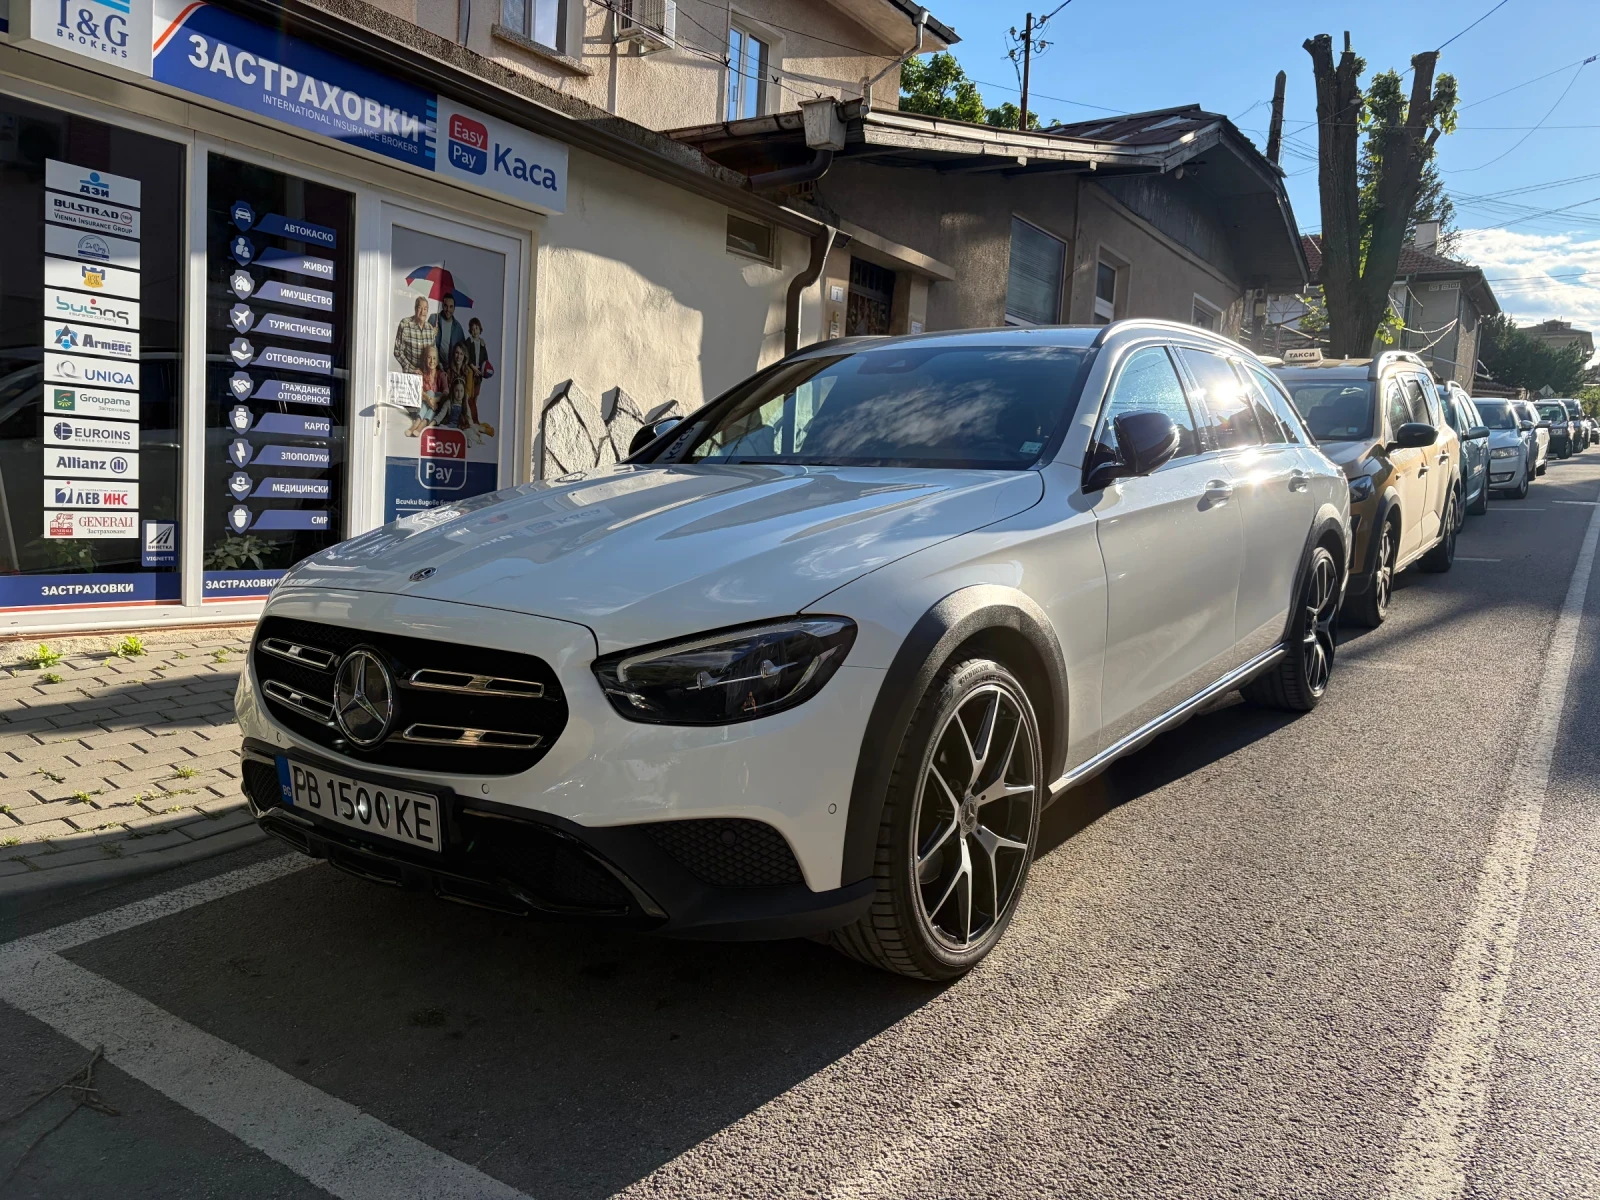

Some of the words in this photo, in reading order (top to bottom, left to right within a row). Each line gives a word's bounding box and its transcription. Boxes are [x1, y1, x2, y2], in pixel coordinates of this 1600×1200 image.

[58, 0, 129, 47] I&G
[56, 28, 128, 58] BROKERS
[188, 34, 419, 142] ЗАСТРАХОВКИ
[262, 94, 332, 125] INTERNATIONAL
[333, 118, 380, 142] INSURANCE
[381, 134, 418, 154] BROKERS
[454, 120, 484, 147] Easy
[453, 146, 476, 168] Pay
[493, 142, 558, 192] Каса
[80, 184, 110, 198] ДЗИ
[54, 198, 119, 220] BULSTRAD
[284, 223, 334, 242] АВТОКАСКО
[302, 260, 332, 274] ЖИВОТ
[280, 288, 332, 306] ИМУЩЕСТВО
[268, 320, 332, 338] ТУРИСТИЧЕСКИ
[82, 334, 132, 352] Armeec
[266, 352, 332, 369] ОТГОВОРНОСТИ
[84, 368, 134, 385] UNIQA
[281, 382, 331, 395] ГРАЖДАНСКА
[80, 394, 130, 406] Groupama
[278, 392, 331, 404] ОТГОВОРНОСТ
[74, 428, 130, 440] EUROINS
[304, 422, 330, 432] КАРГО
[426, 435, 460, 458] Easy
[56, 456, 107, 470] Allianz
[280, 452, 330, 462] ЗЛОПОЛУКИ
[426, 462, 453, 484] Pay
[272, 484, 329, 494] МЕДИЦИНСКИ
[76, 492, 100, 504] ЛЕВ
[104, 493, 128, 506] ИНС
[79, 516, 134, 528] GENERALI
[311, 516, 328, 524] СМР
[41, 584, 134, 596] ЗАСТРАХОВКИ
[282, 784, 292, 797] BG
